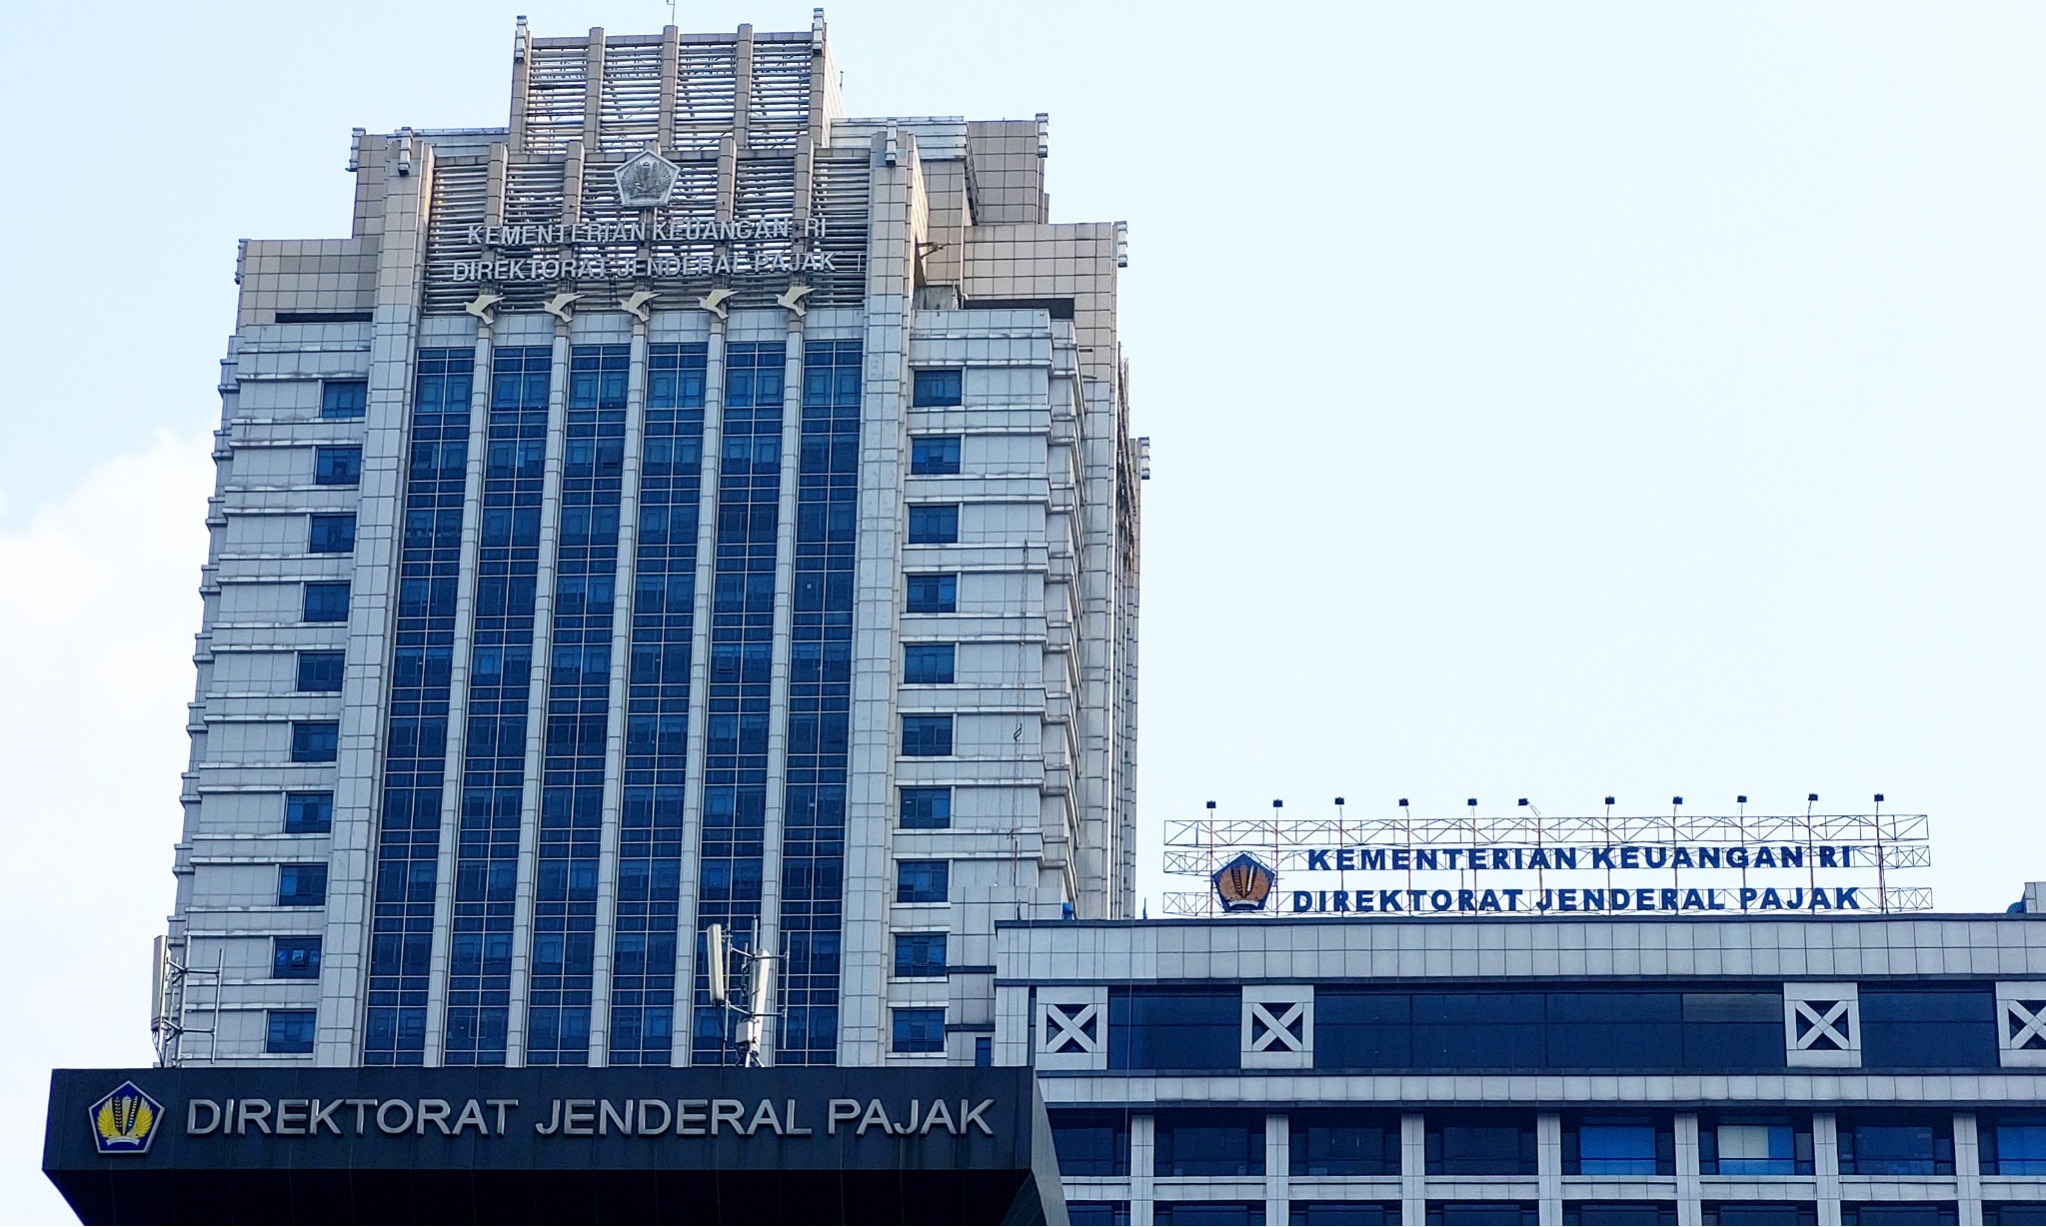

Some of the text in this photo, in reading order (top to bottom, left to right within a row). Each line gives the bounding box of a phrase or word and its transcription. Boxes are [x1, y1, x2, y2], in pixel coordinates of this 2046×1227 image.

[467, 218, 827, 246] KEMENTERIAN KEUANGAN RI
[453, 252, 836, 282] DIREKTORAT JENDERAL PAJAK
[1308, 846, 1851, 871] KEMENTERIAN KEUANGAN RI
[1293, 887, 1860, 912] DIREKTORAT JENDERAL PAJAK
[185, 1098, 996, 1137] DIREKTORAT JENDERAL PAJAK
